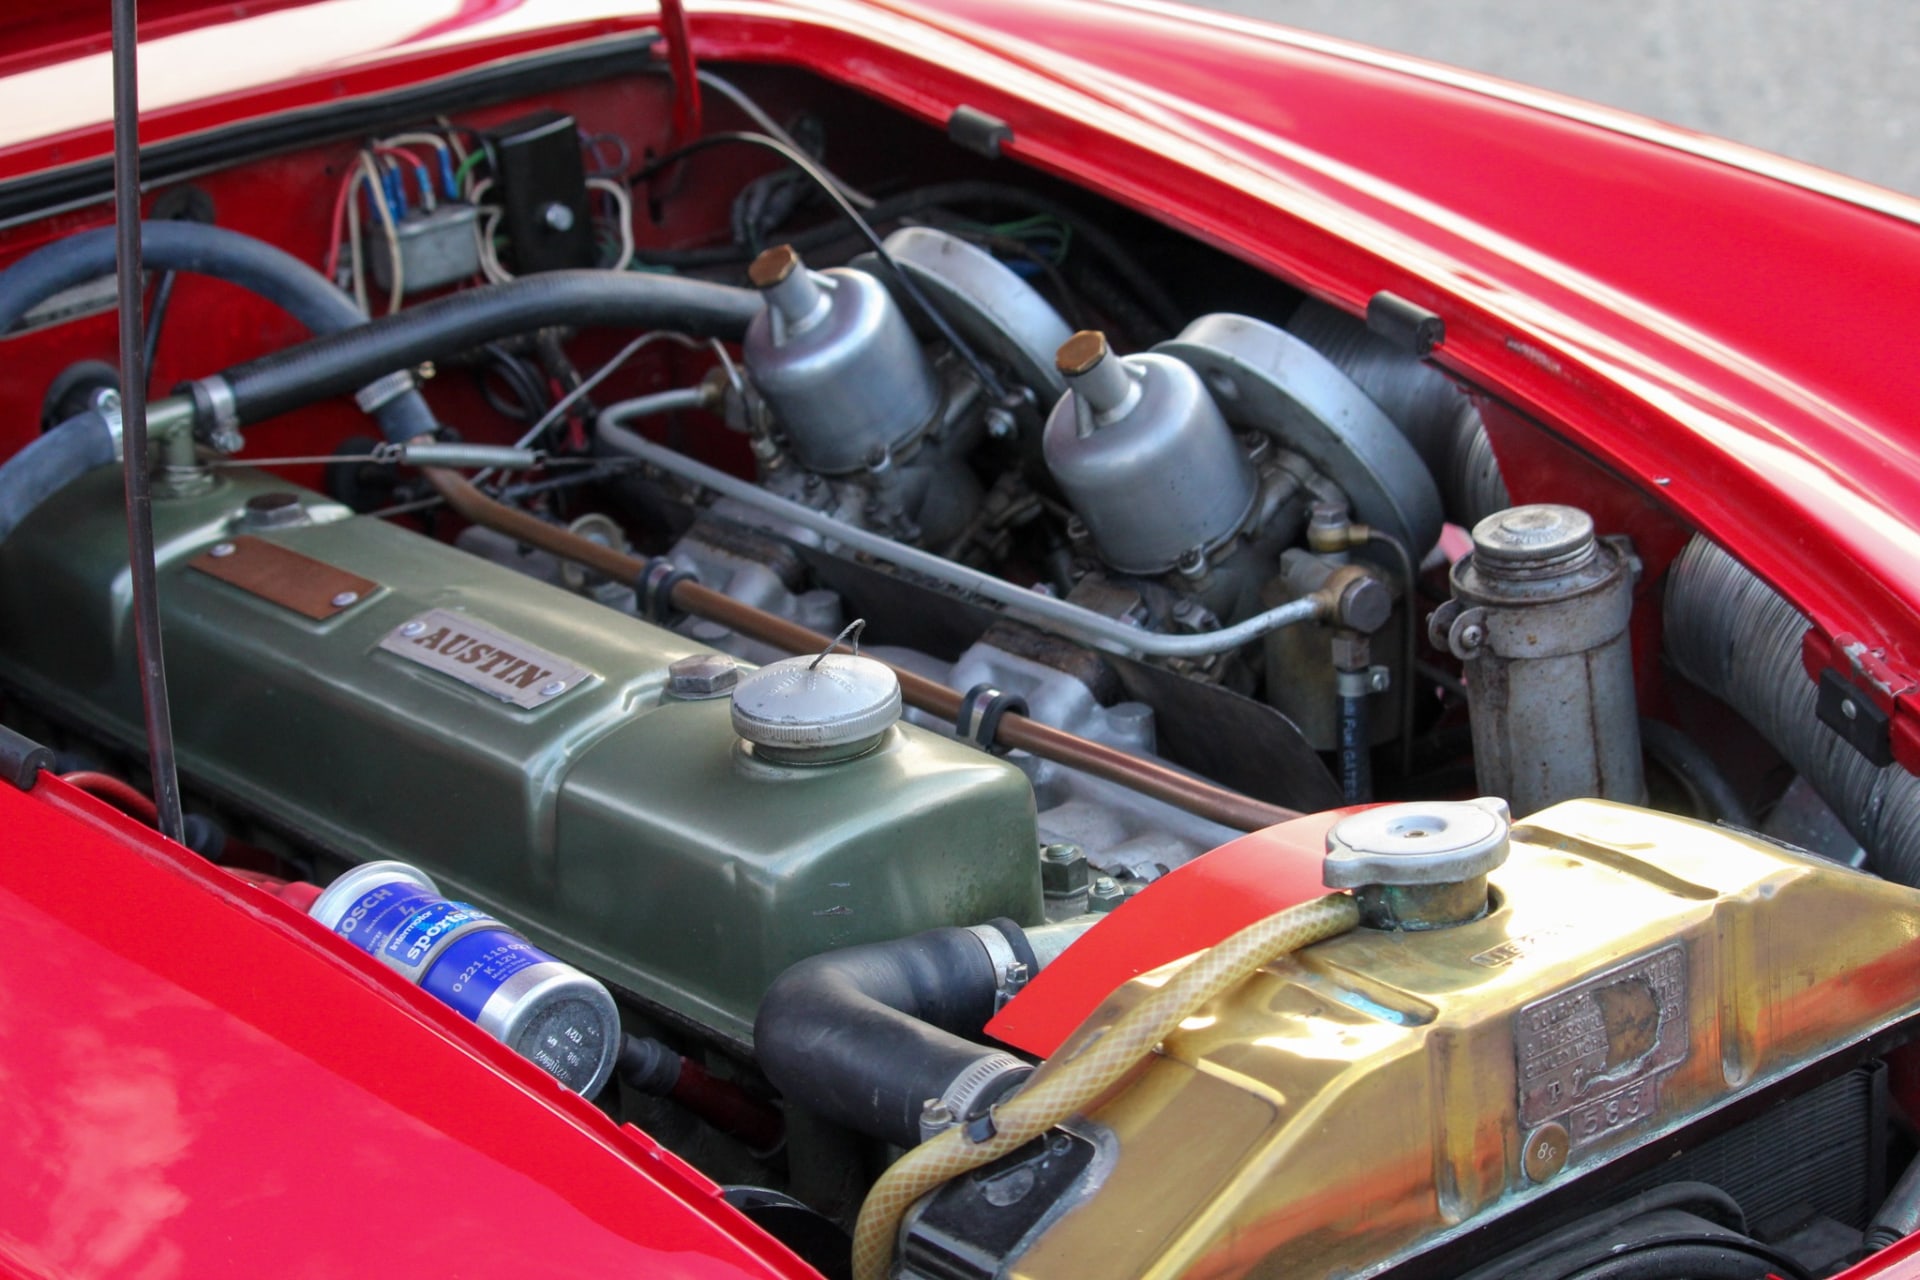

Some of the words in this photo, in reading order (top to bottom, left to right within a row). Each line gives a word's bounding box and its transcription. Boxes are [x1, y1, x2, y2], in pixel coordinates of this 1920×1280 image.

[412, 627, 551, 689] AUSTIN
[407, 913, 468, 960] sports
[452, 983, 461, 993] 0
[460, 961, 482, 982] 221
[483, 946, 507, 963] 119
[484, 965, 495, 974] K
[495, 953, 517, 967] 12V
[1583, 1091, 1640, 1133] 583
